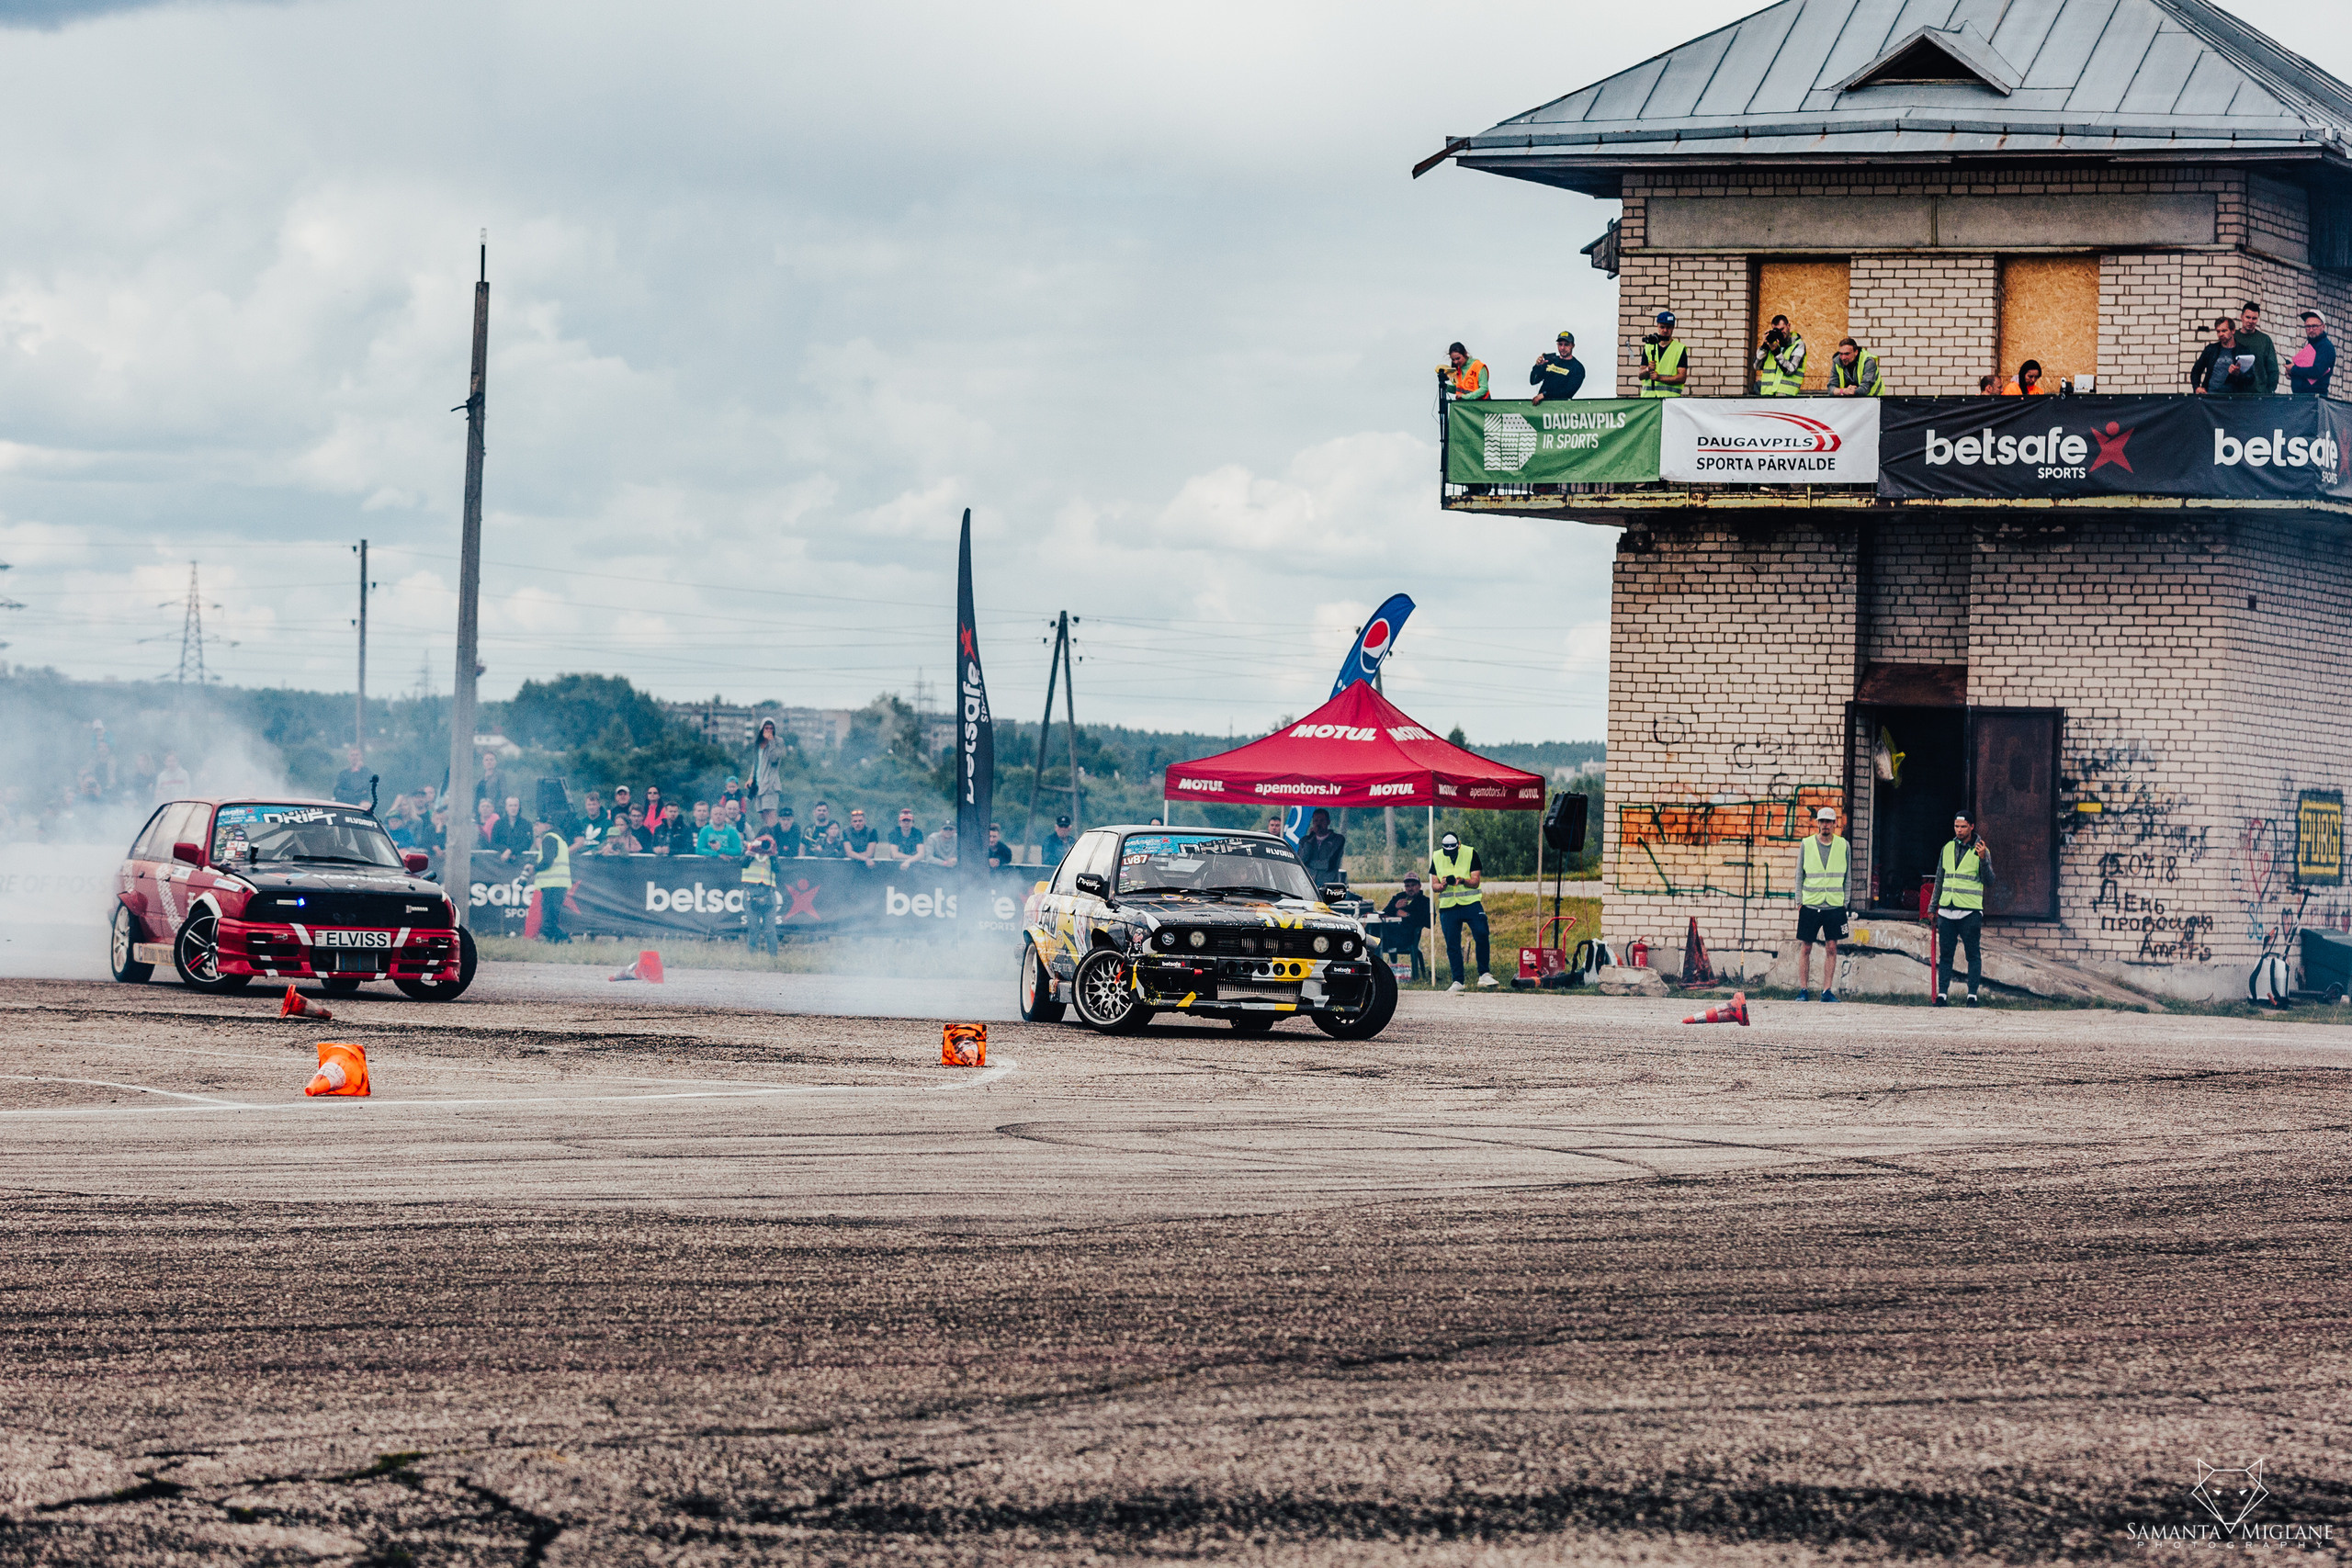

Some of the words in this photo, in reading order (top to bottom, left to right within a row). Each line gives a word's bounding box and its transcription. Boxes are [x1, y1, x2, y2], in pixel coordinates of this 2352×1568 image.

[1543, 412, 1626, 431] DAUGAVPILS
[1543, 434, 1555, 449] IR
[1556, 434, 1600, 449] SPORTS
[1697, 436, 1814, 448] DAUGAVPILS
[1925, 426, 2088, 467] betsafe
[2213, 428, 2339, 468] betsafe
[1696, 457, 1754, 471] SPORTA
[1757, 455, 1836, 472] PĀRVALDE
[2037, 467, 2086, 479] SPORTS
[2321, 469, 2338, 485] SPORTS
[1289, 724, 1377, 742] MOTUL
[1386, 726, 1434, 741] MOTUL
[1179, 778, 1225, 792] MOTUL
[1255, 782, 1342, 796] apemotors.lv
[1369, 783, 1415, 796] MOTUL
[1438, 784, 1457, 796] MOTUL
[1469, 786, 1508, 799] apemotors.lv
[1518, 788, 1539, 799] MOTUL
[263, 811, 337, 826] DRIFT
[2301, 812, 2340, 863] PUBG
[1123, 854, 1148, 865] LV87
[468, 876, 536, 908] safe
[646, 881, 784, 913] betsa
[886, 886, 1016, 920] betse
[505, 908, 529, 919] SPO
[978, 921, 1016, 931] SPORTS
[326, 931, 387, 947] ELVISS
